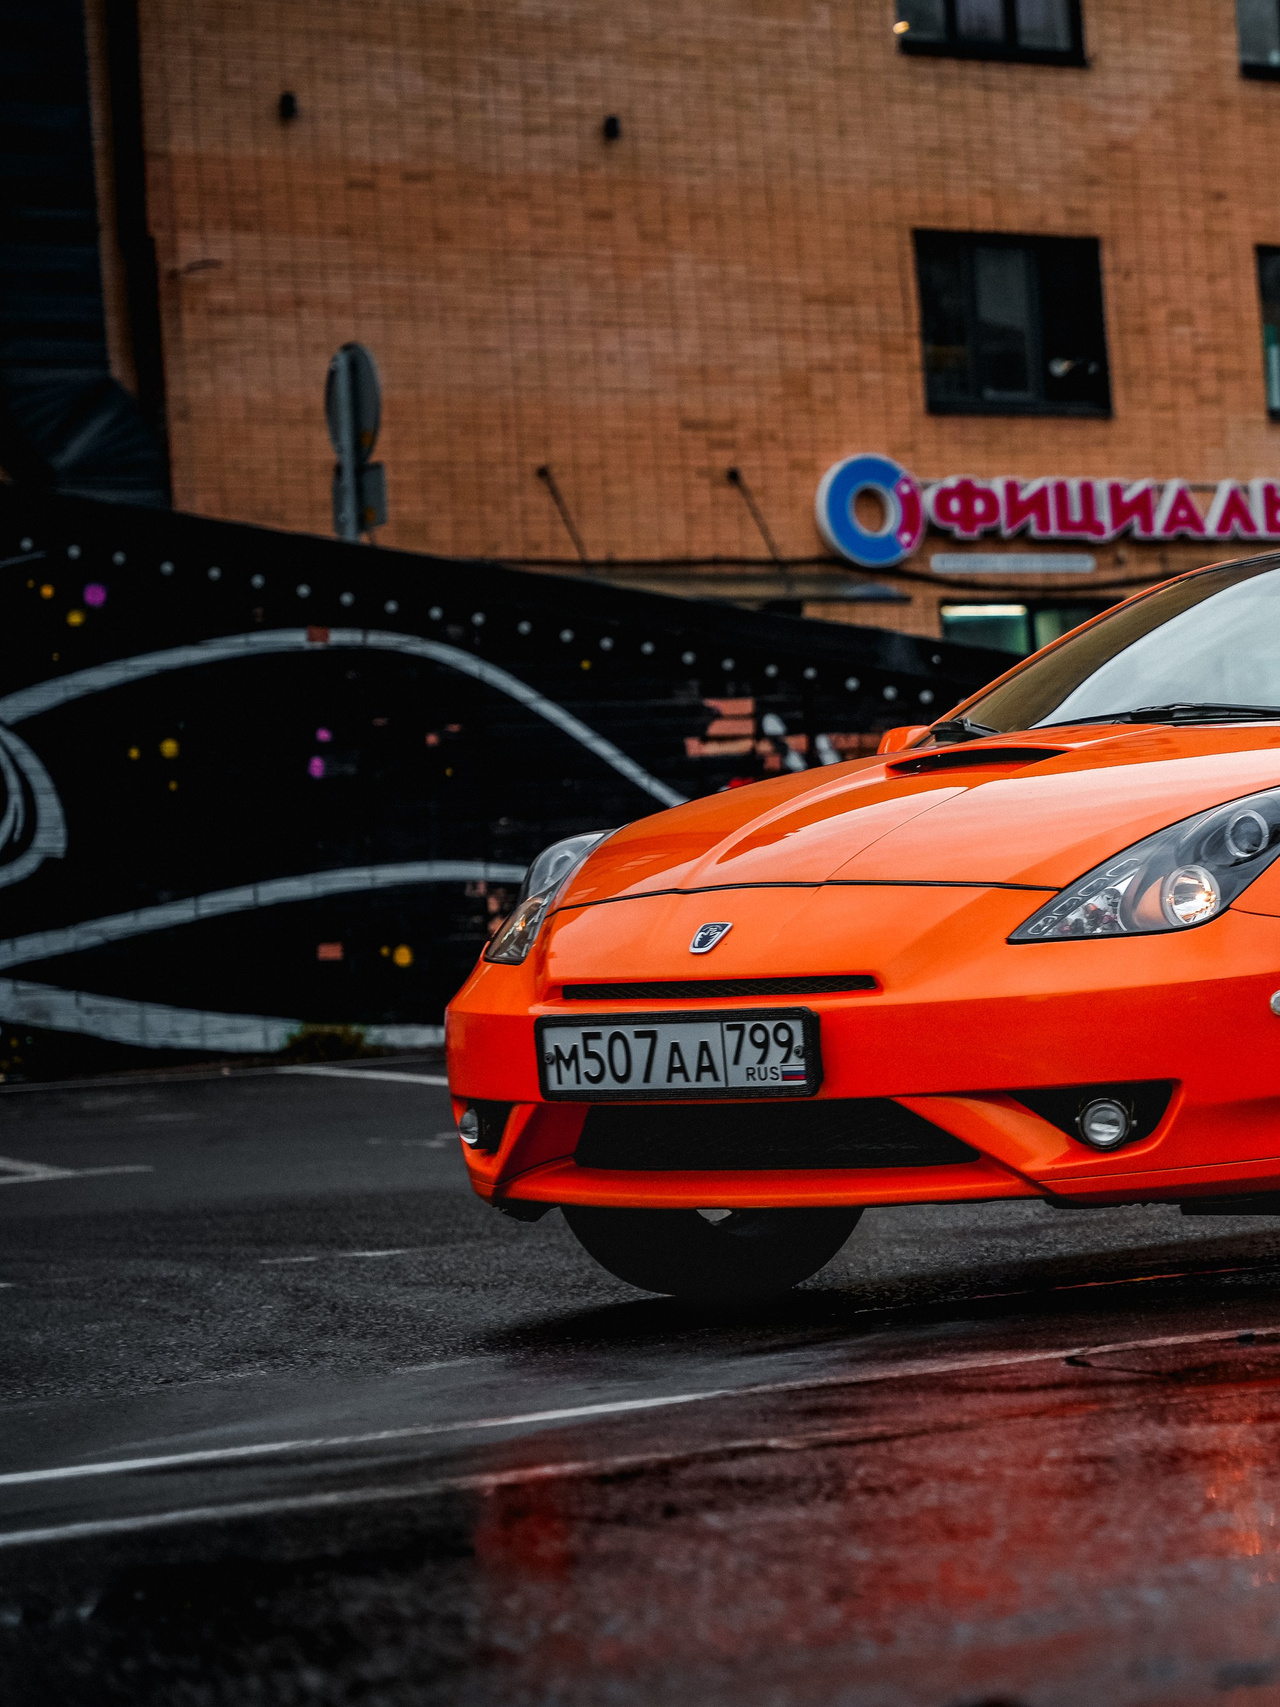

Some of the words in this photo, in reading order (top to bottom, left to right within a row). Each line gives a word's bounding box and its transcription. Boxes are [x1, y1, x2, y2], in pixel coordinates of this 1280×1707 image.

[553, 1029, 721, 1084] М507АА
[725, 1022, 794, 1066] 799
[746, 1067, 780, 1081] RUS
